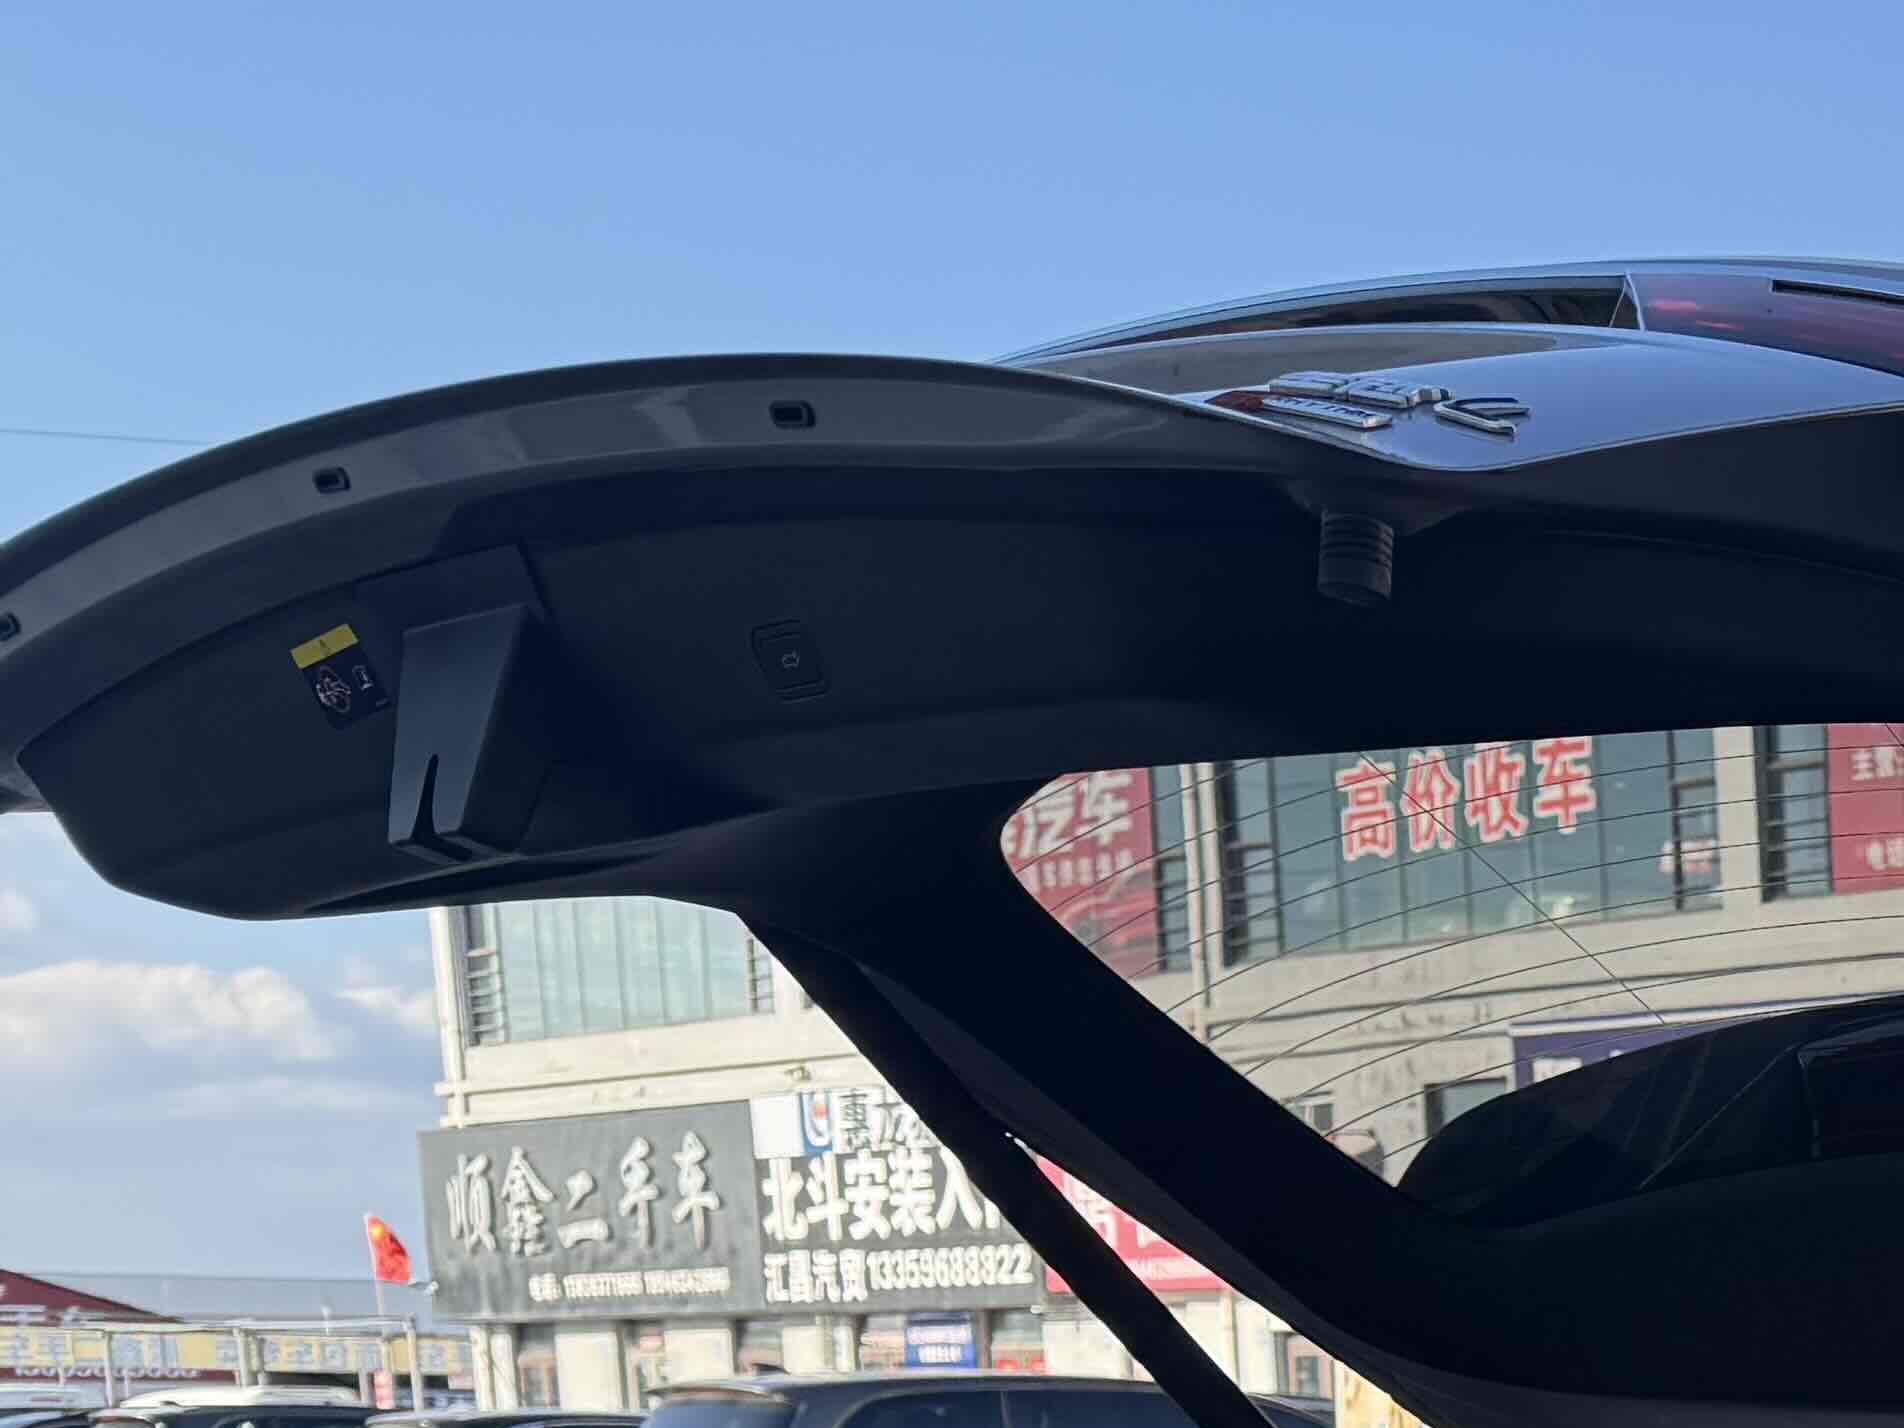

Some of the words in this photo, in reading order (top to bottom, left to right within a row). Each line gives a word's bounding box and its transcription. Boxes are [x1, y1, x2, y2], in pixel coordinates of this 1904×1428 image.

[1335, 736, 1597, 862] 高价收车
[446, 1131, 720, 1257] 顺鑫二手车
[762, 1147, 1001, 1241] 北斗安装入
